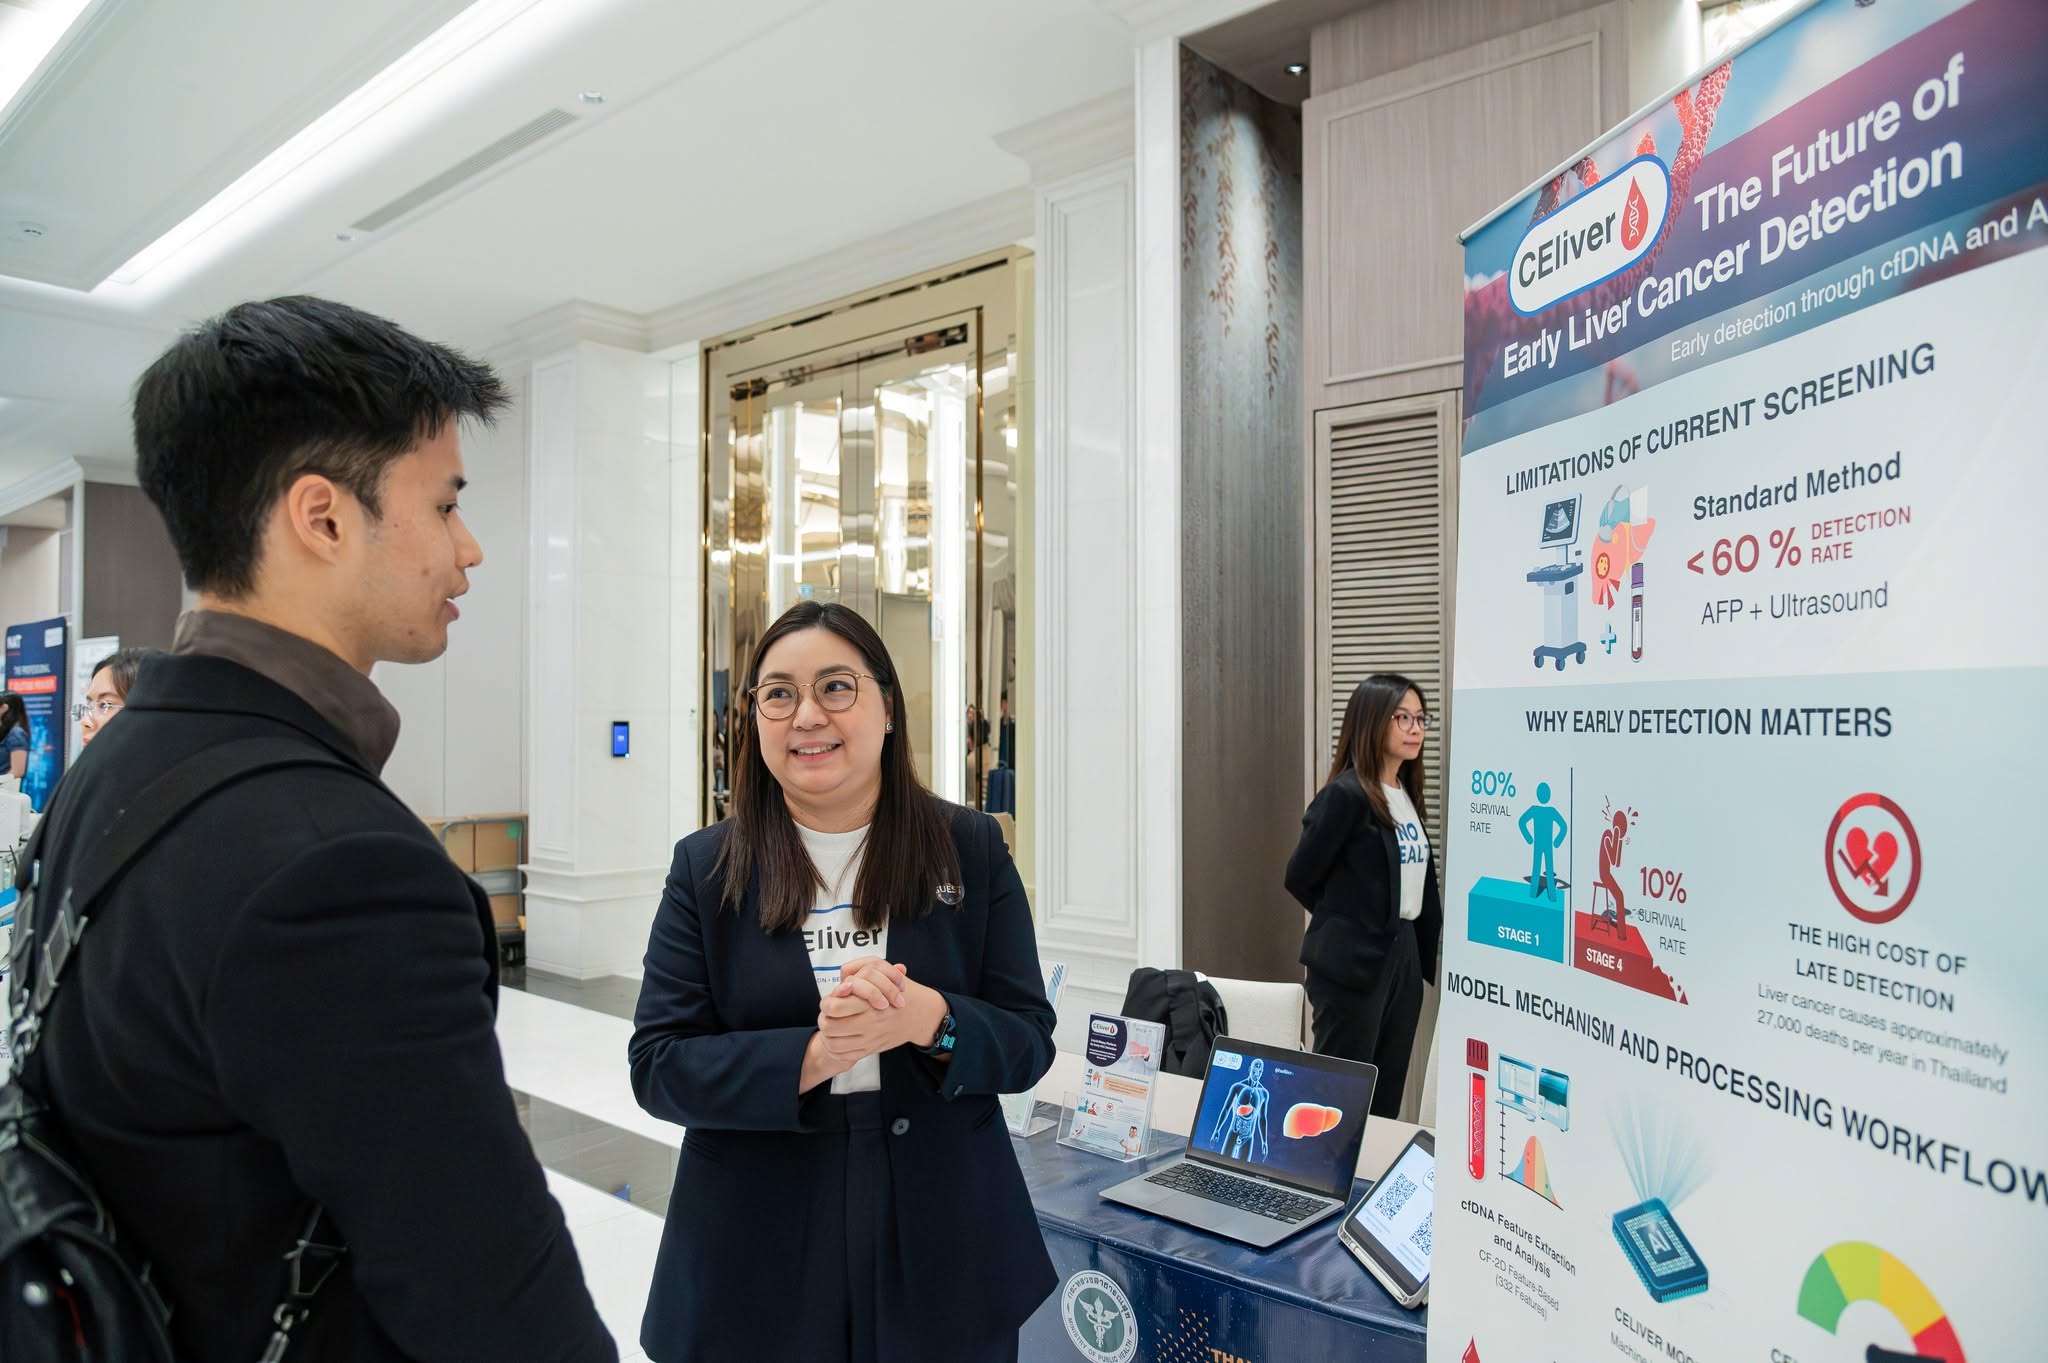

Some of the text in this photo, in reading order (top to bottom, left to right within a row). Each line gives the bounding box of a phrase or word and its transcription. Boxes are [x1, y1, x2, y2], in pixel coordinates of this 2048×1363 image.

[1694, 51, 1964, 231] The Future of
[1503, 141, 1962, 379] Early Liver Cancer Detection
[1518, 212, 1616, 288] CEliver
[1671, 331, 1709, 362] Early
[1714, 299, 1796, 345] detection
[1800, 265, 1875, 313] through
[1880, 231, 1959, 281] cfDNA
[1965, 206, 2018, 250] and
[1506, 342, 1936, 496] LIMITATIONS OF CURRENT SCREENING
[1693, 451, 1901, 520] Standard Method
[1812, 505, 1911, 540] DETECTION
[1812, 541, 1853, 564] RATE
[1701, 598, 1743, 625] AFP
[1770, 580, 1888, 619] Ultrasound
[1526, 707, 1892, 737] WHY EARLY DETECTION MATTERS
[1471, 770, 1516, 797] 80%
[1470, 802, 1511, 817] SURVIVAL
[1470, 821, 1491, 834] RATE
[1640, 866, 1687, 904] 10%
[1497, 925, 1540, 947] STAGE 1
[1638, 908, 1687, 932] SURVIVAL
[1586, 948, 1623, 972] STAGE 4
[1659, 936, 1687, 955] RATE
[1788, 923, 1967, 976] THE HIGH COST OF
[1796, 958, 1955, 1013] LATE DETECTION
[1758, 983, 2009, 1067] Liver cancer causes approximately
[1447, 971, 1511, 1008] MODEL
[1515, 989, 1615, 1047] MECHANISM
[1619, 1029, 1660, 1064] AND
[1666, 1045, 1833, 1130] PROCESSING
[1757, 1009, 2008, 1095] 27,000 deaths per year in Thailand
[1461, 1200, 1576, 1276] cfDNA Feature Extraction
[1494, 1234, 1551, 1278] and Analysis
[1647, 1230, 1672, 1255] AI
[1479, 1249, 1559, 1311] CF-2D Feature-Based
[1495, 1273, 1548, 1321] (332 Features)
[1614, 1307, 1663, 1352] CELIVER
